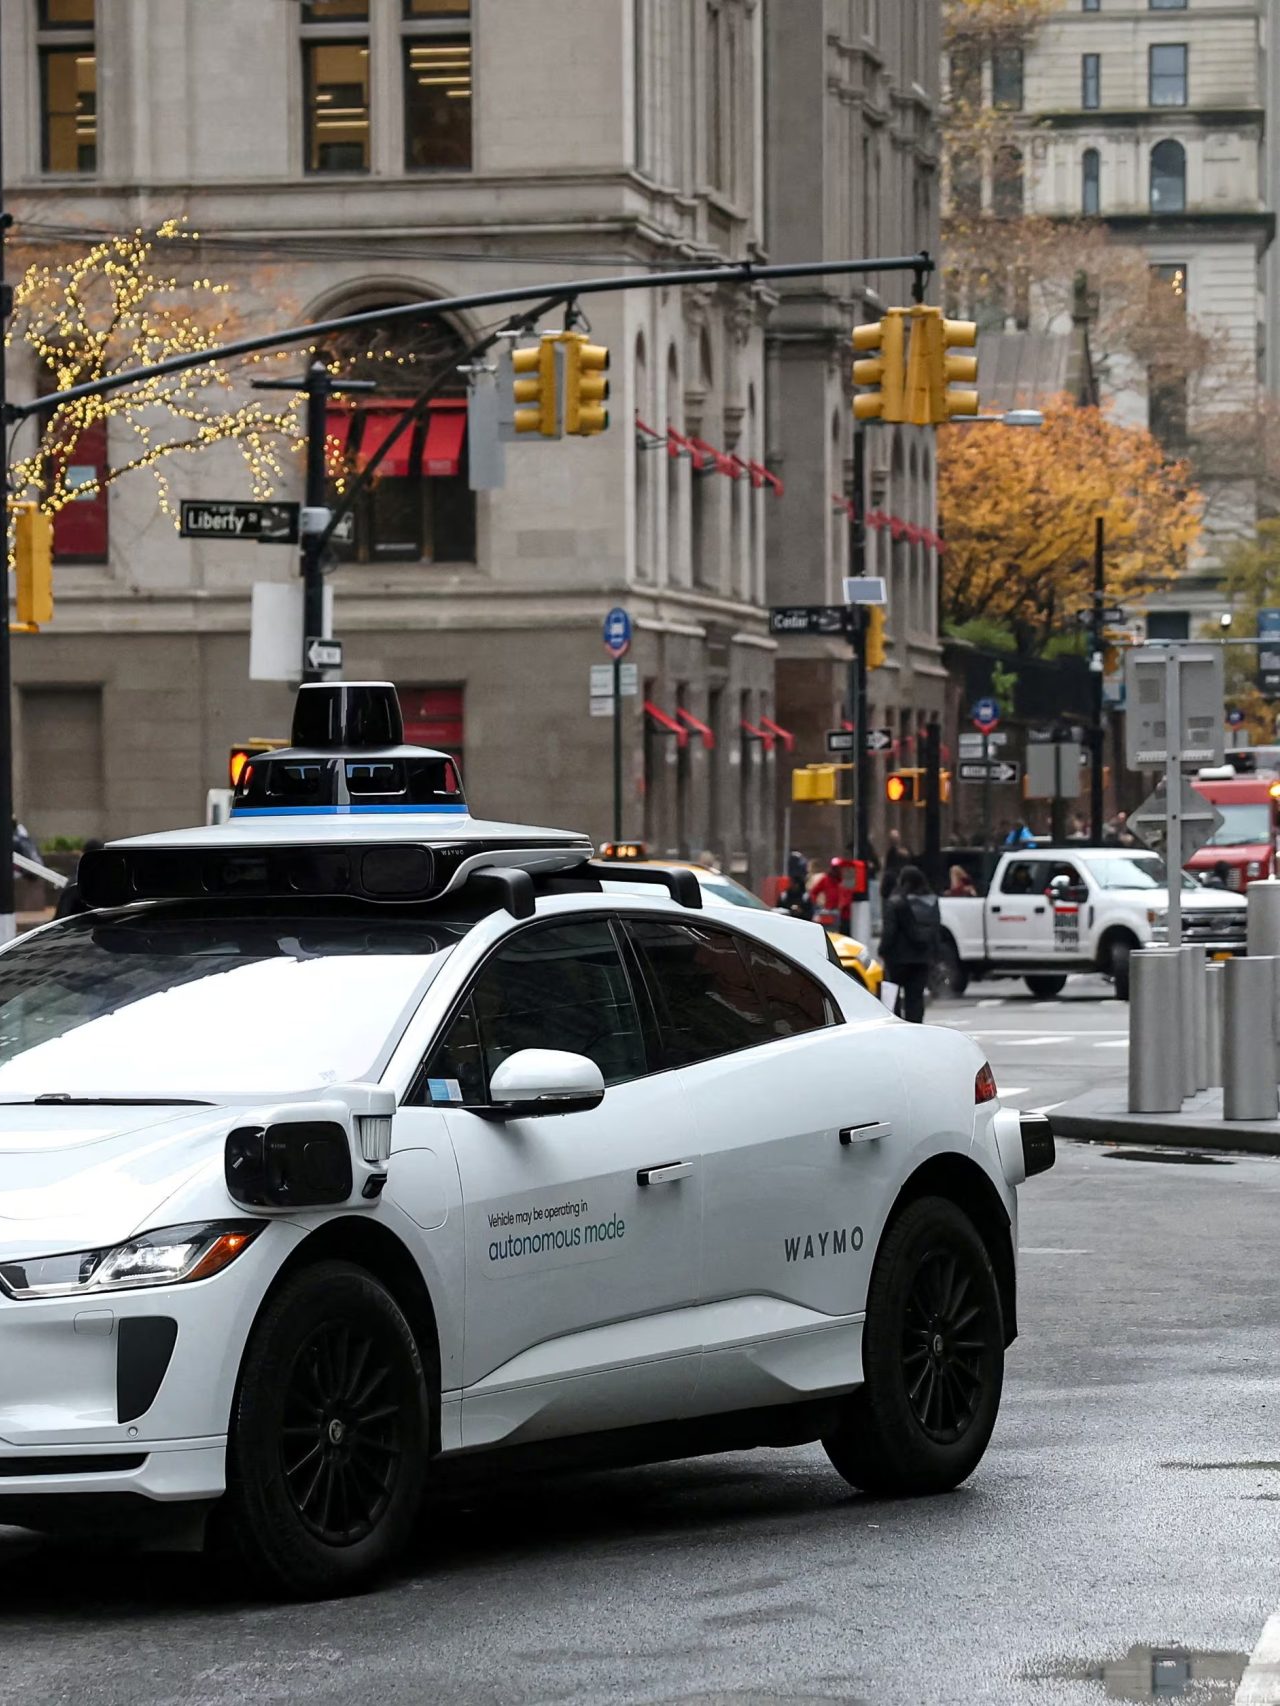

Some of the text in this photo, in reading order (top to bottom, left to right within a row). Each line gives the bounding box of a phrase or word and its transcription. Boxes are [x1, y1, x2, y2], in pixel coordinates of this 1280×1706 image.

[188, 510, 245, 534] Liberty
[488, 1199, 588, 1228] Vehicle may be operating in
[488, 1212, 625, 1261] autonomous mode
[784, 1225, 864, 1263] WAYMO
